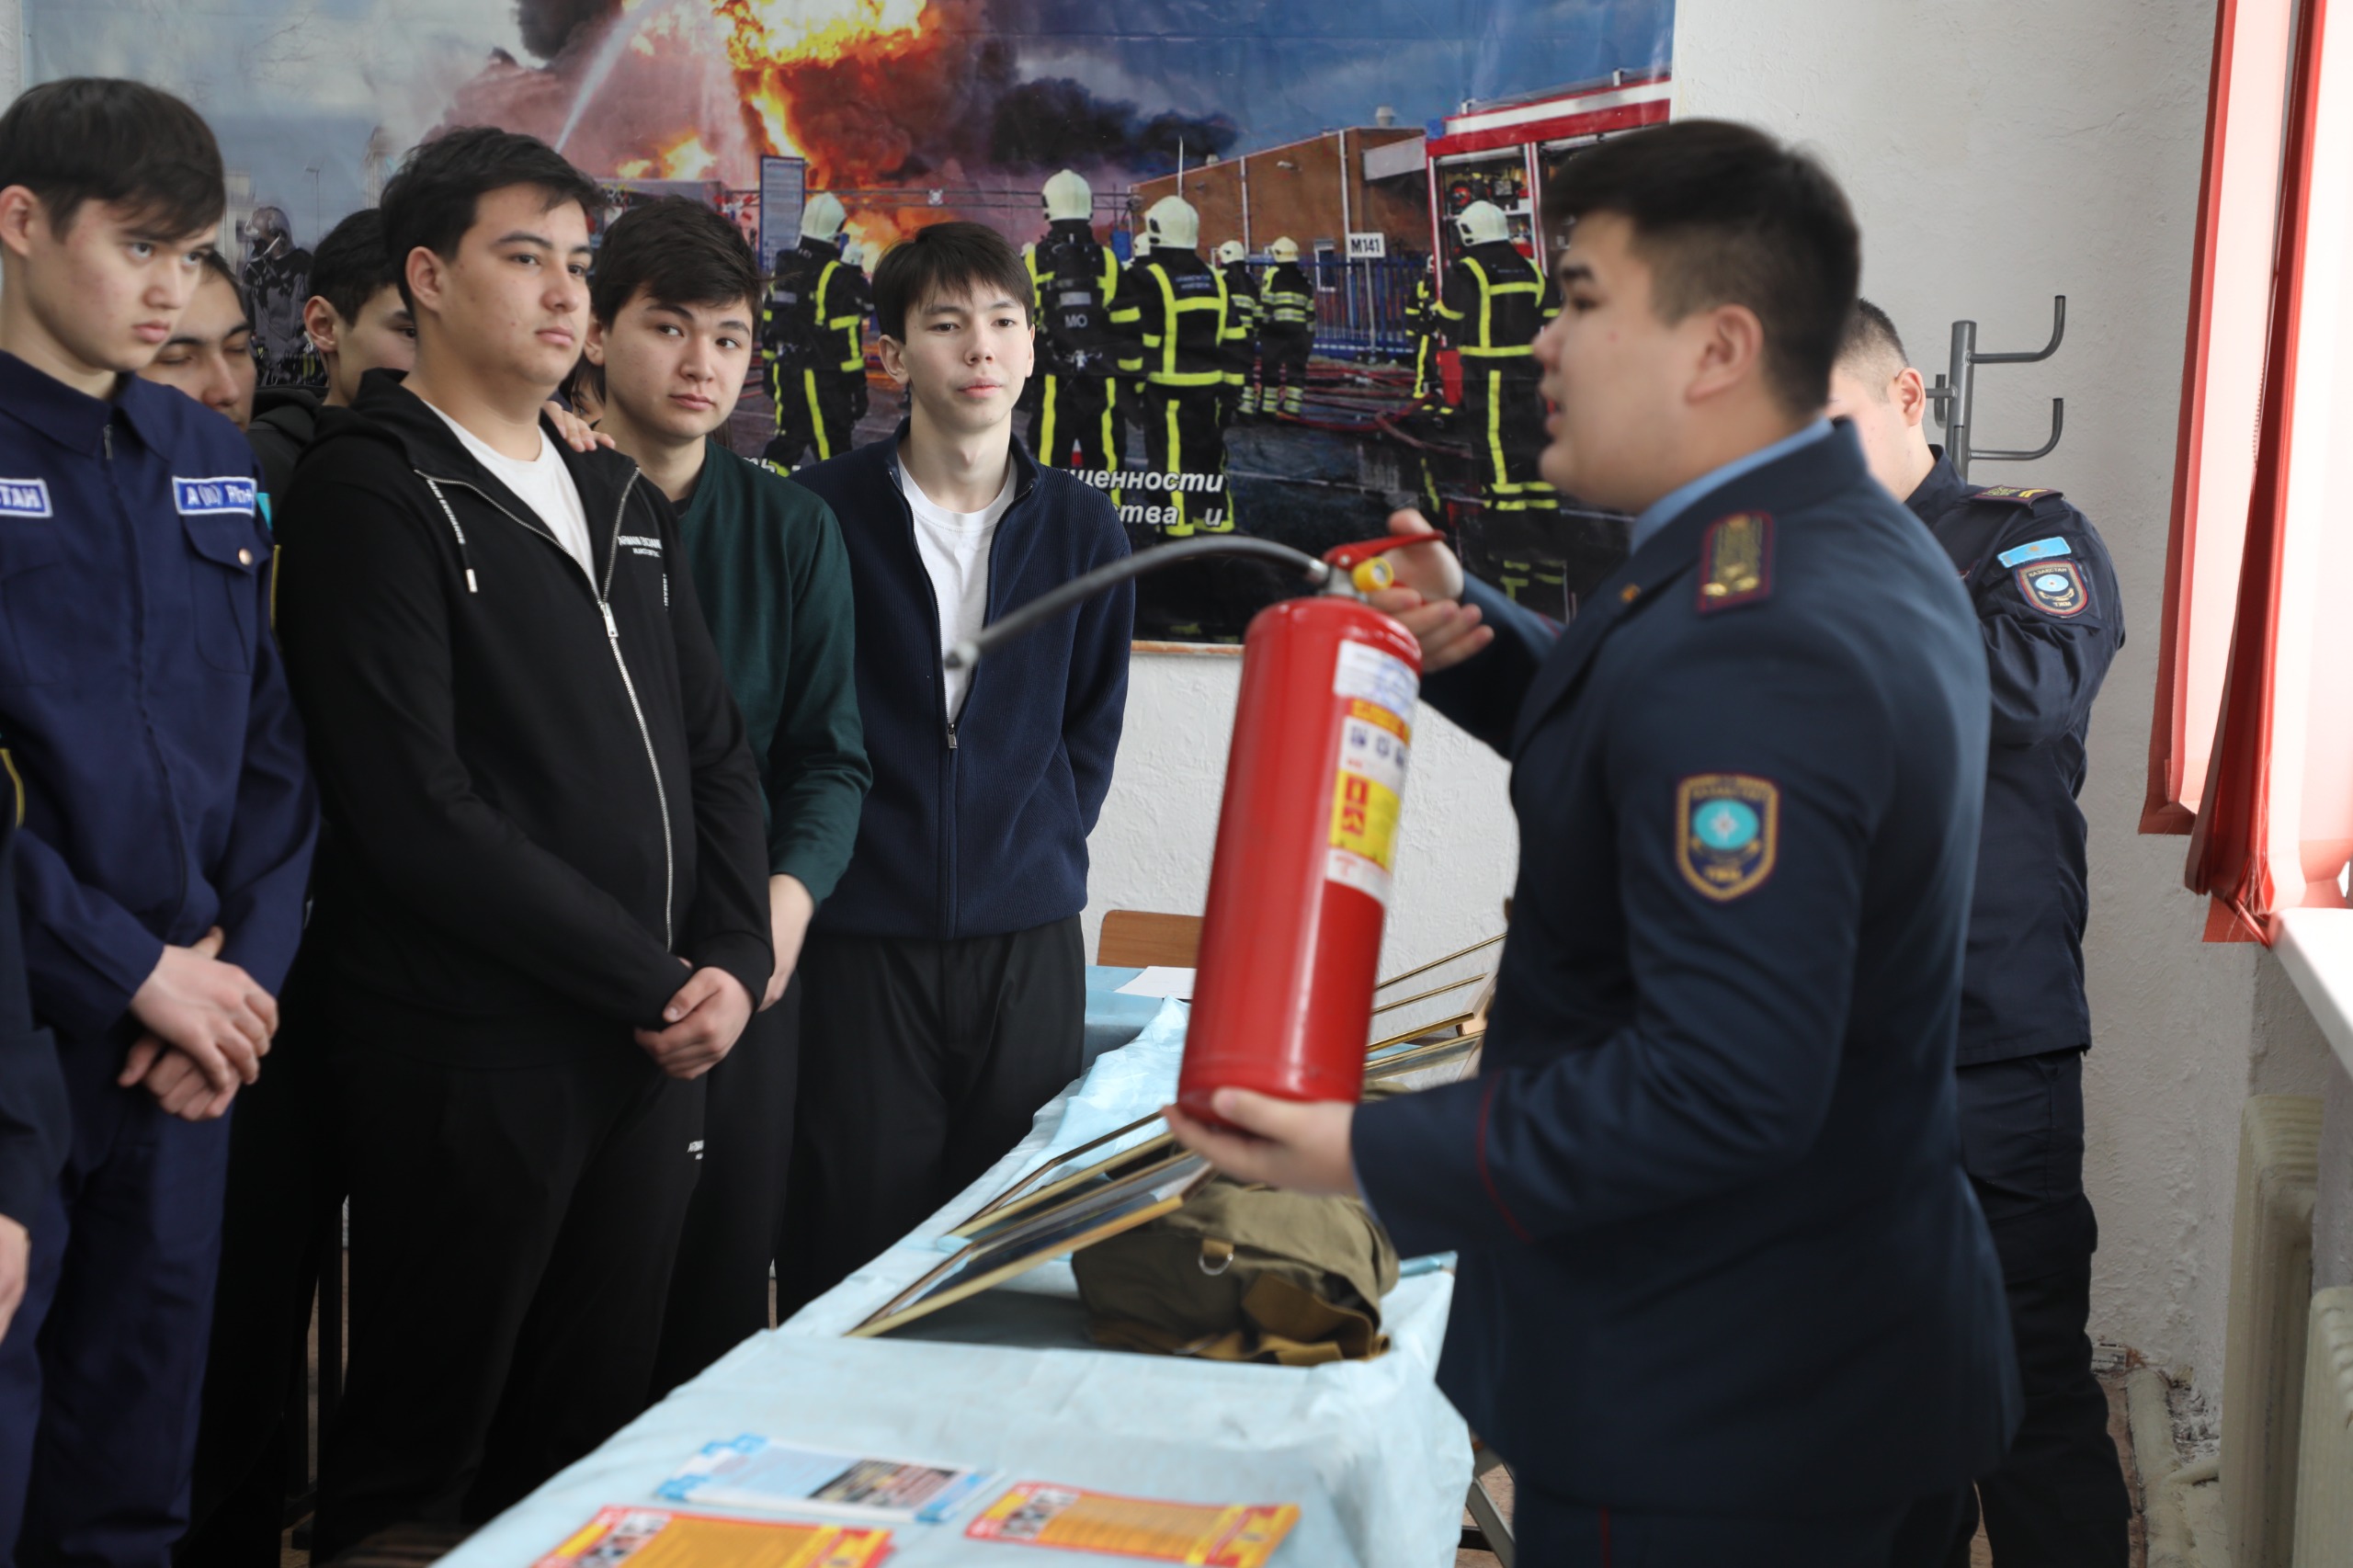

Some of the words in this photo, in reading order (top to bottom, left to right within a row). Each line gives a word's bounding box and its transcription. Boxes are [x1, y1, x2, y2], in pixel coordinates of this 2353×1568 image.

[1351, 238, 1381, 253] M141
[1062, 469, 1224, 493] щенности
[0, 485, 43, 508] ТАН
[1113, 504, 1179, 525] тва
